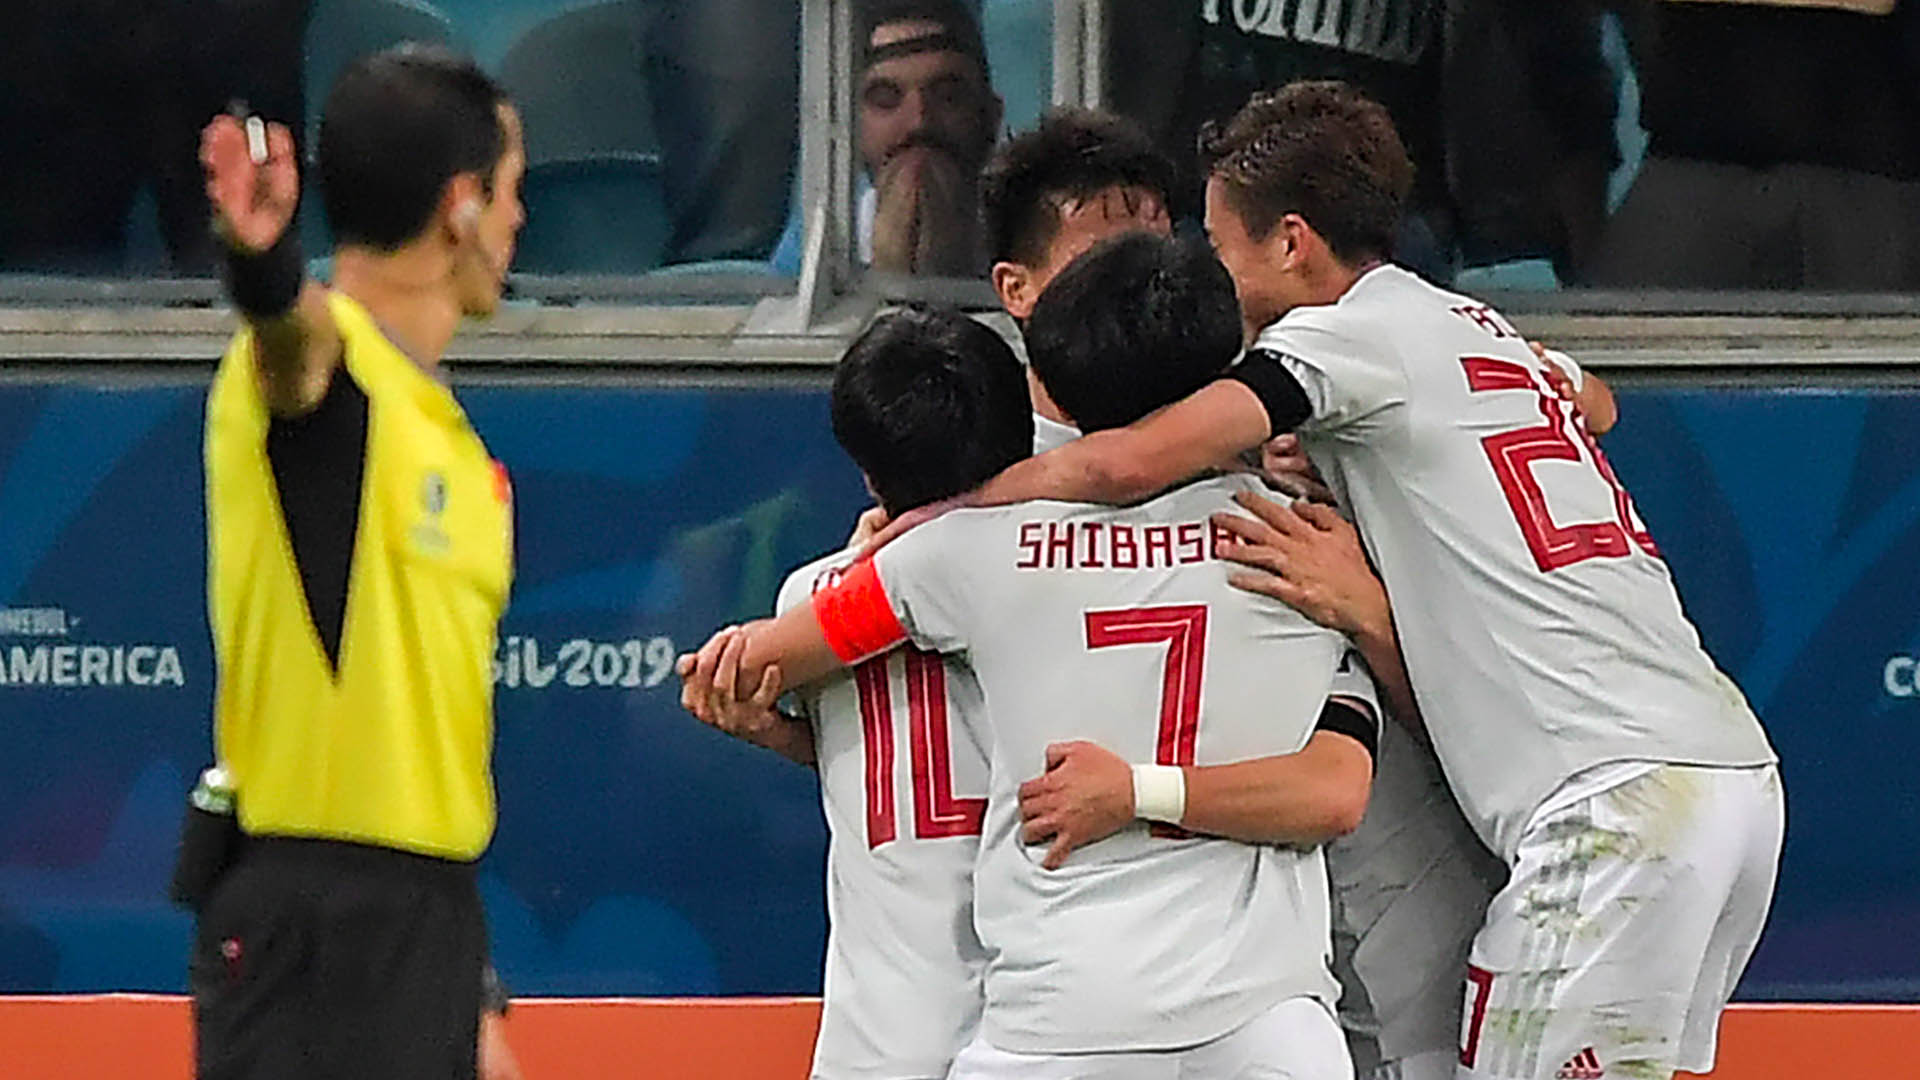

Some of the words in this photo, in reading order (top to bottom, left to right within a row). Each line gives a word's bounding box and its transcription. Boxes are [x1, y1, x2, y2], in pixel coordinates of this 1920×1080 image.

[0, 645, 185, 686] MERICA
[558, 637, 675, 688] 2019
[1084, 604, 1210, 839] 7
